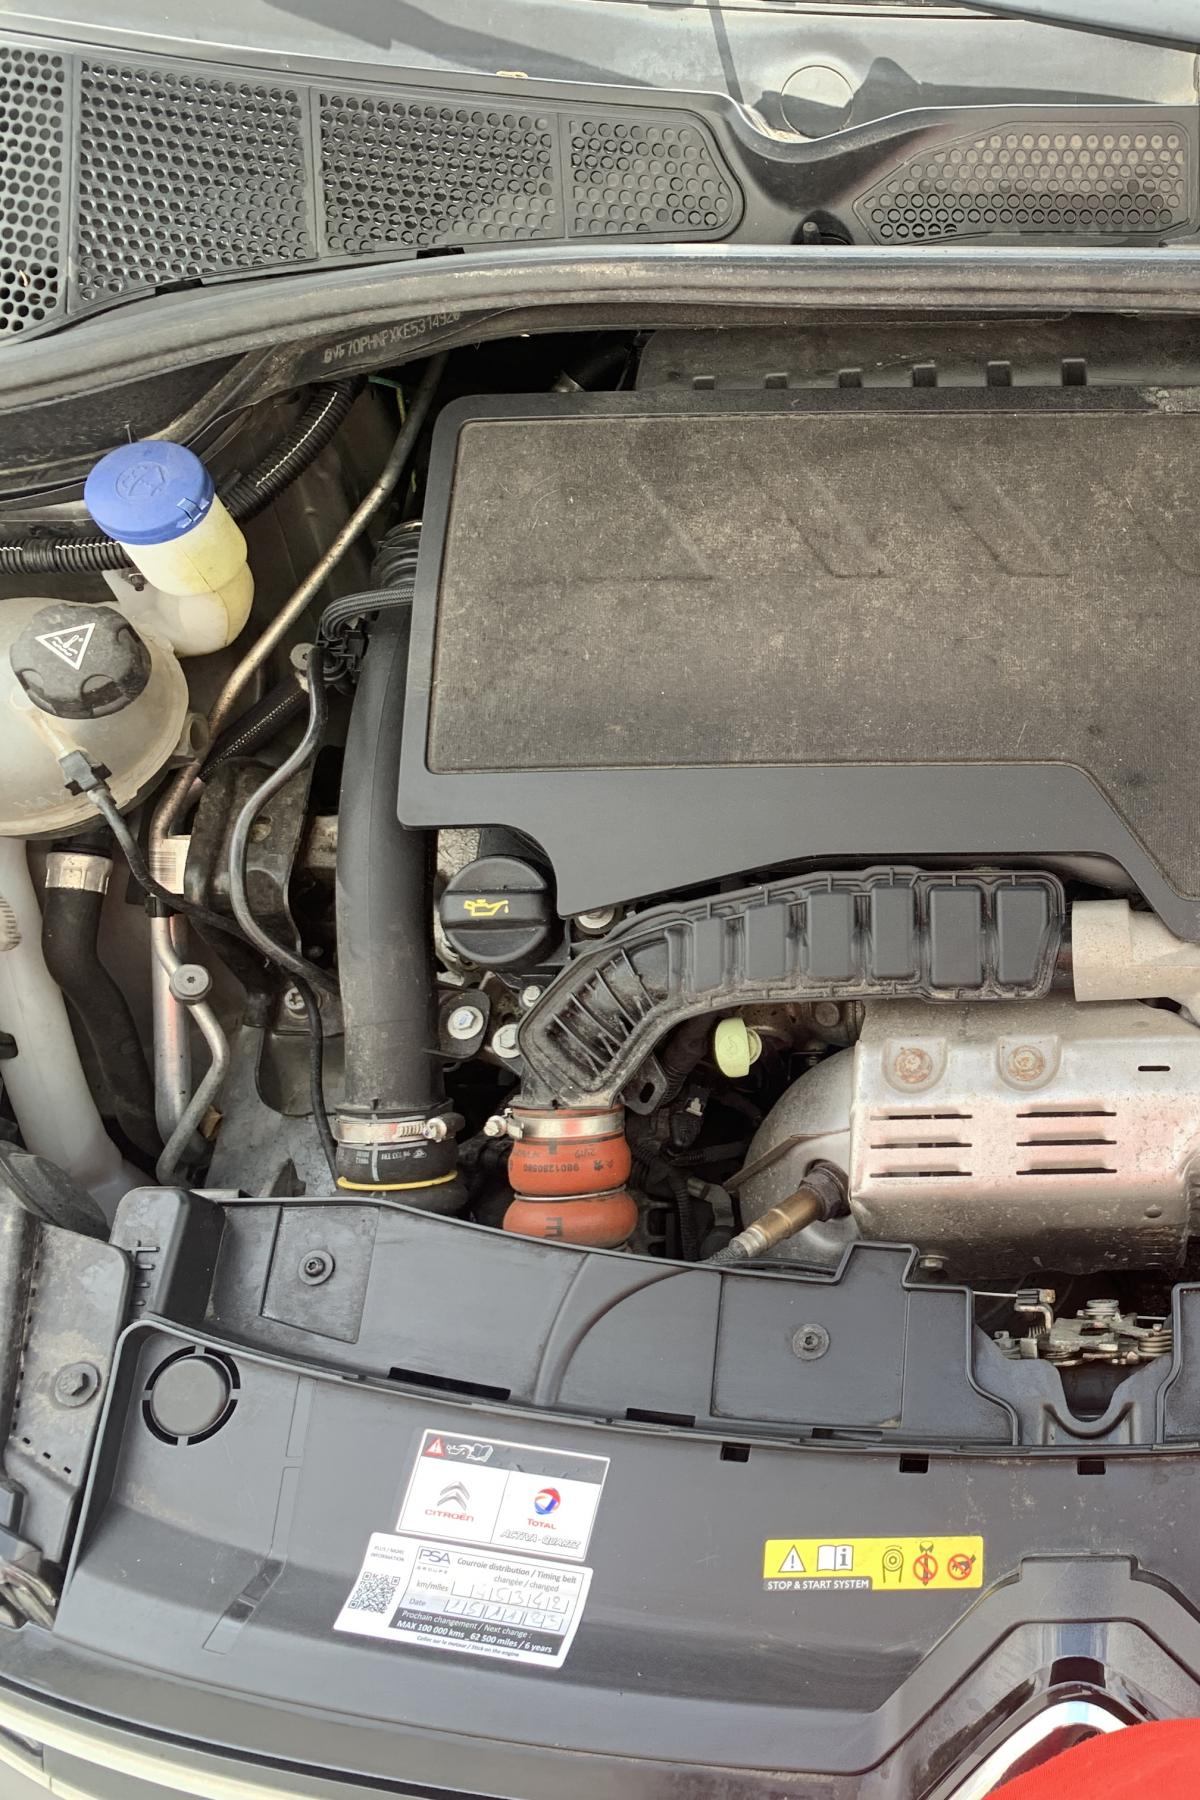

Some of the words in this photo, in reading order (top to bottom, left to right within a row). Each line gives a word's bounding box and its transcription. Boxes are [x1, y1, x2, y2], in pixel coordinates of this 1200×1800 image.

[527, 1518, 557, 1530] TOTAL
[500, 1529, 538, 1543] ACTIVA
[541, 1536, 582, 1549] QUARTZ
[419, 1549, 451, 1565] PSA
[457, 1557, 488, 1570] Courroie
[489, 1563, 530, 1576] distribution
[537, 1571, 561, 1583] Timing
[562, 1575, 577, 1584] belt
[416, 1580, 449, 1592] km/miles
[493, 1575, 523, 1588] changée
[529, 1581, 559, 1592] changed
[767, 1581, 792, 1590] STOP
[793, 1581, 800, 1590] &
[802, 1580, 831, 1589] START
[833, 1580, 869, 1589] SYSTEM
[409, 1598, 426, 1606] Date
[402, 1611, 433, 1622] Prochain
[434, 1615, 478, 1630] changement
[484, 1624, 501, 1633] Next
[502, 1628, 528, 1638] change
[396, 1620, 416, 1630] MAX
[418, 1623, 432, 1632] 100
[433, 1625, 449, 1635] 000
[449, 1628, 465, 1638] kms
[470, 1632, 480, 1641] 62
[481, 1633, 496, 1644] 500
[497, 1637, 518, 1647] miles
[524, 1640, 530, 1649] 6
[530, 1643, 553, 1654] years
[471, 1644, 484, 1652] Stick
[502, 1650, 520, 1658] engine
